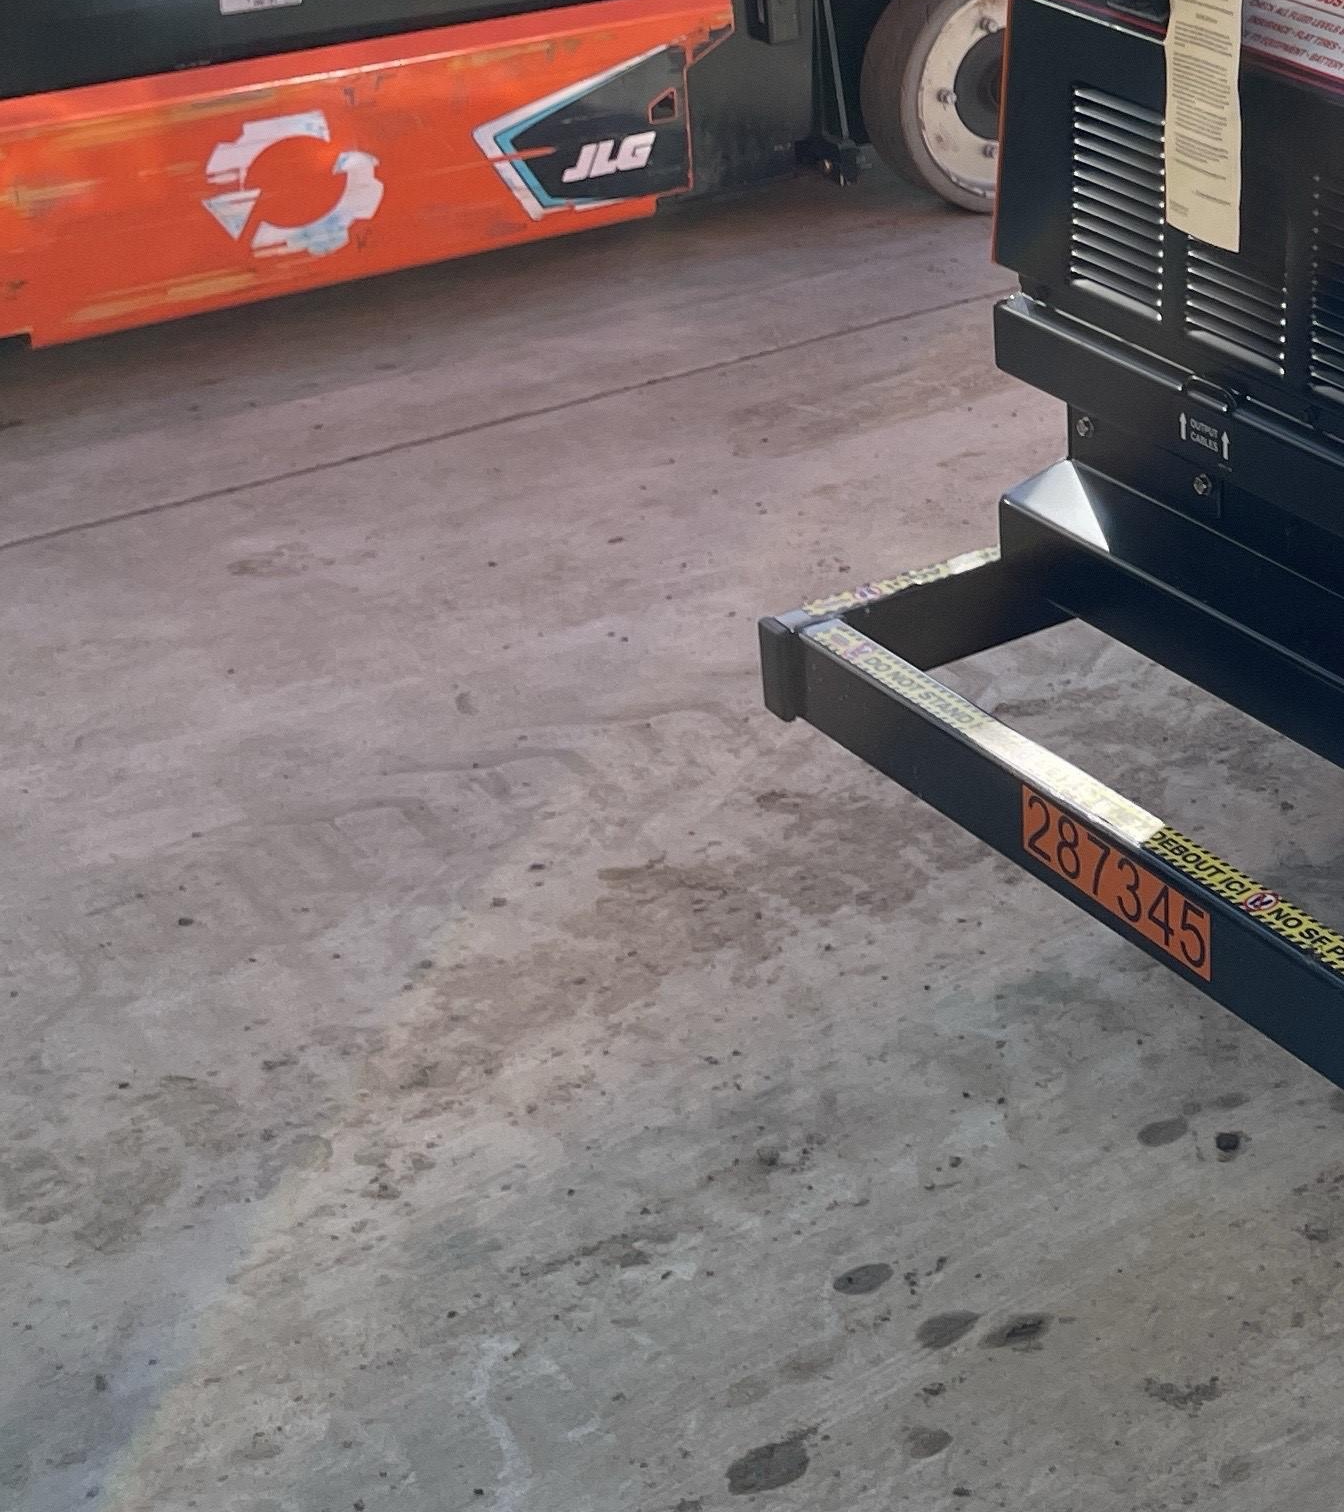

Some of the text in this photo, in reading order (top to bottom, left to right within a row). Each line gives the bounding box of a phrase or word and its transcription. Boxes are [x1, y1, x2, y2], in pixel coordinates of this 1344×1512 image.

[561, 130, 656, 183] JLG
[1028, 796, 1206, 968] 287345
[1150, 831, 1251, 896] DEBOUT ICI
[1268, 907, 1303, 929] NO
